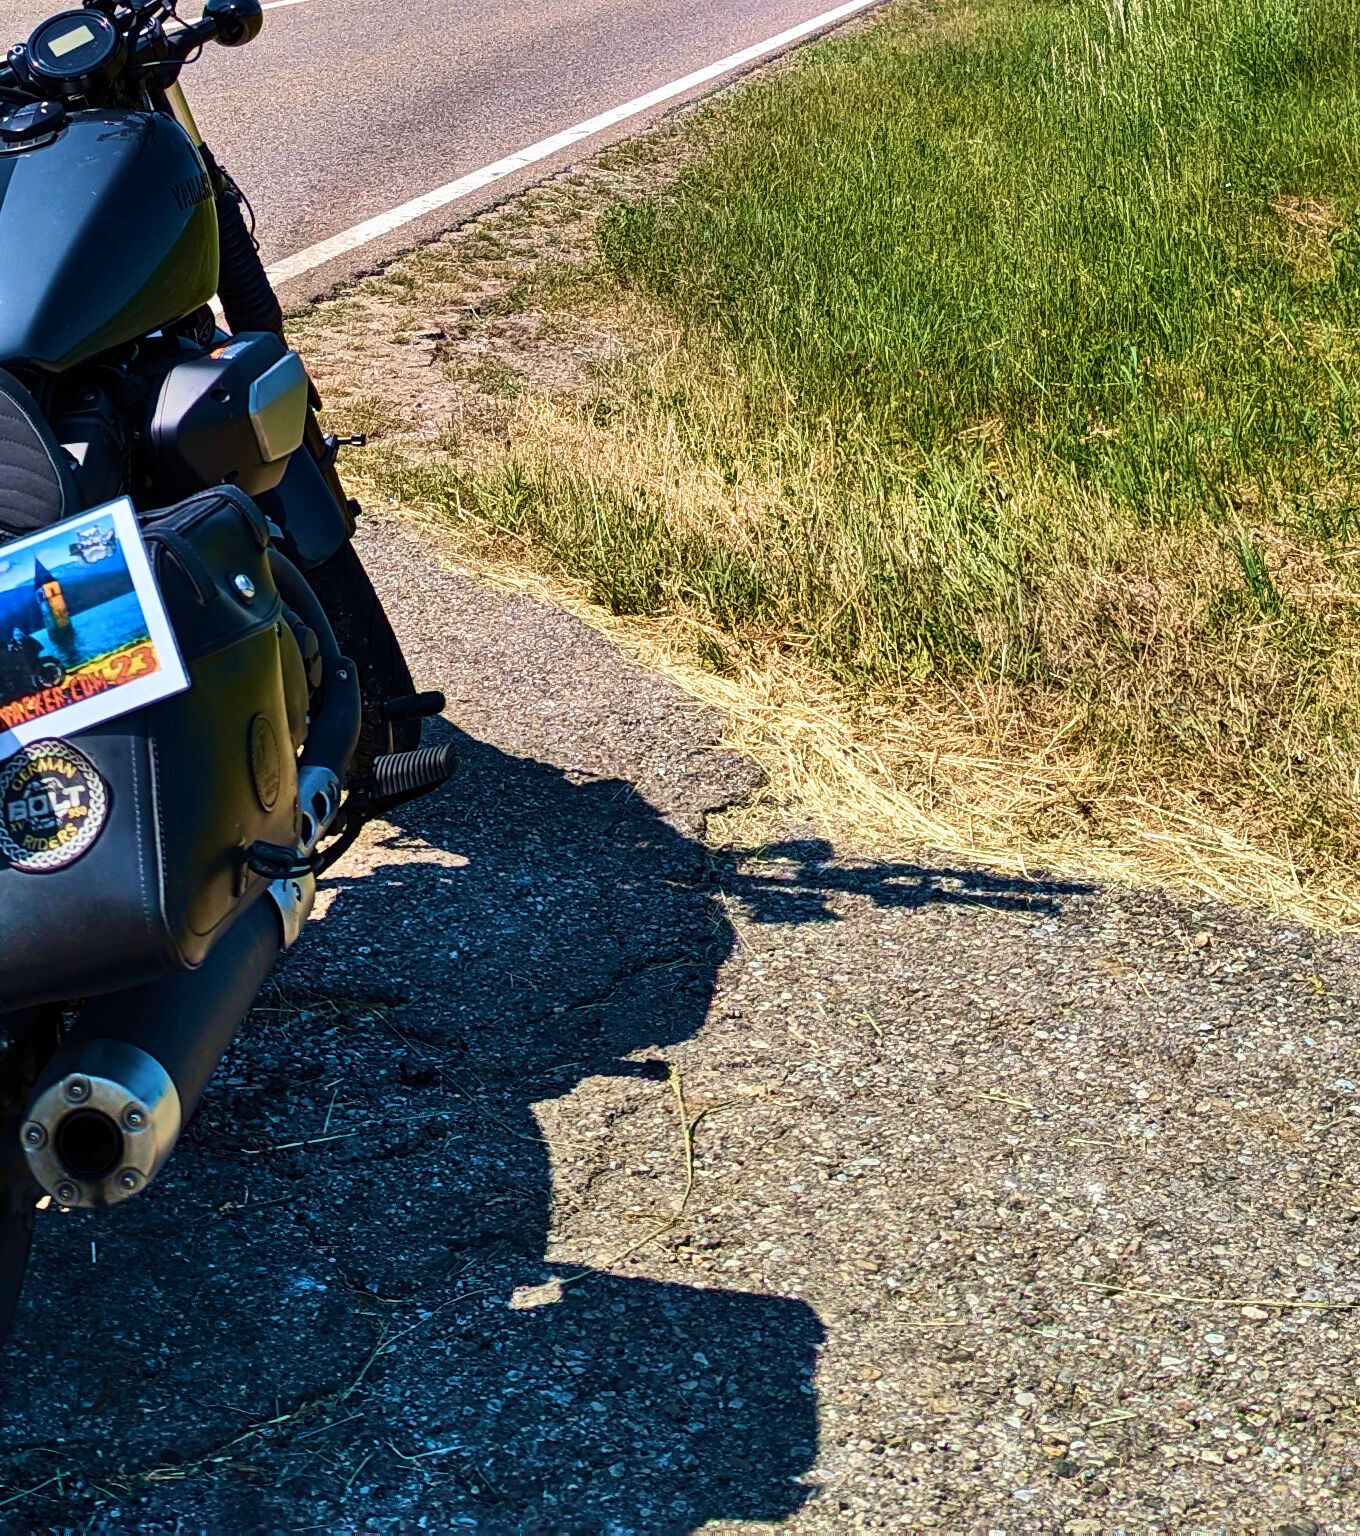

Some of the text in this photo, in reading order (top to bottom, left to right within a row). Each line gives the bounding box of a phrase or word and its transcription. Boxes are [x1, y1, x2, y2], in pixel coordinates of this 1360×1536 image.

[110, 646, 156, 684] 23
[11, 757, 78, 792] GERMAN
[7, 784, 86, 822] BOLT
[23, 822, 78, 851] RIDERS
